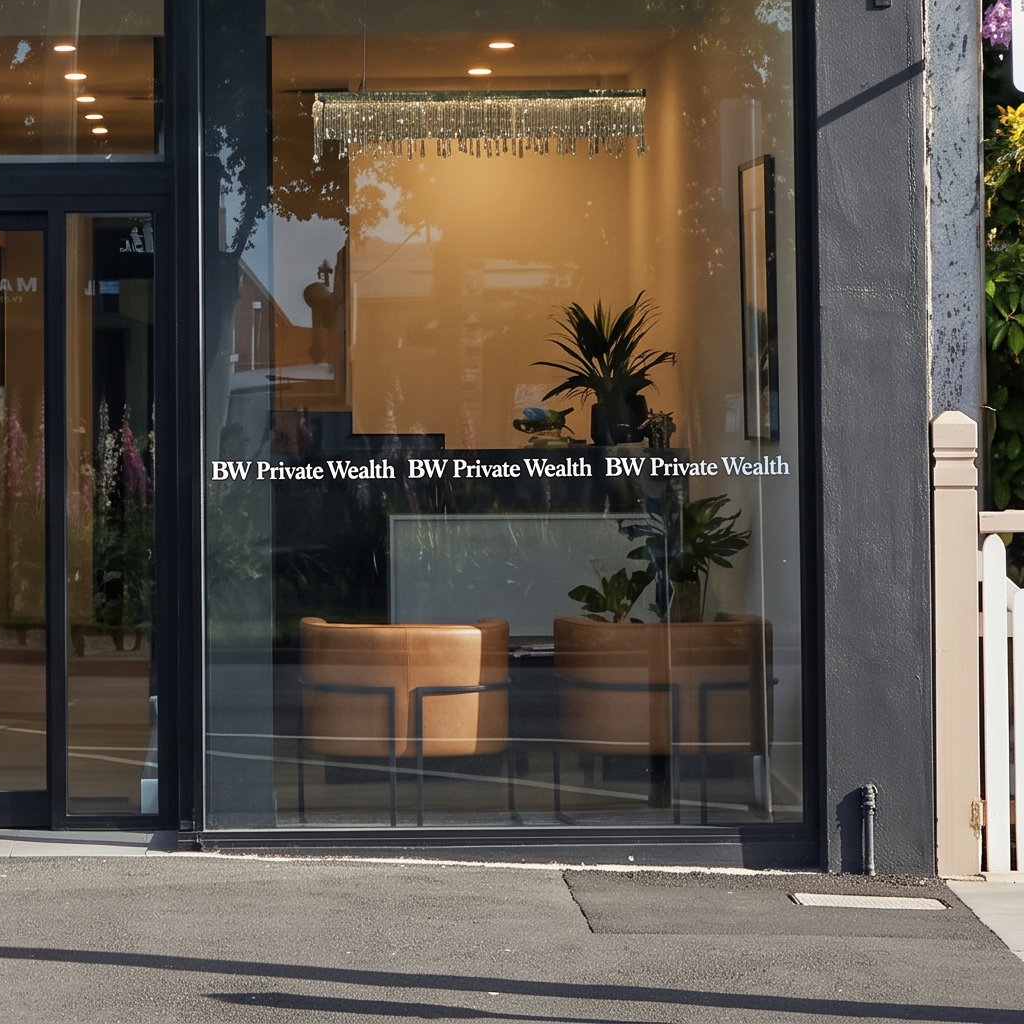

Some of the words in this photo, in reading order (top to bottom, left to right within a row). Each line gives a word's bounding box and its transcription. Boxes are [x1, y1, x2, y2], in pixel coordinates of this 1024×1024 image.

[211, 461, 253, 481] BW
[256, 461, 324, 480] Private
[326, 459, 397, 479] Wealth
[407, 459, 449, 479] BW
[452, 459, 521, 478] Private
[522, 457, 593, 477] Wealth
[605, 457, 646, 477] BW
[649, 457, 718, 476] Private
[721, 455, 791, 476] Wealth
